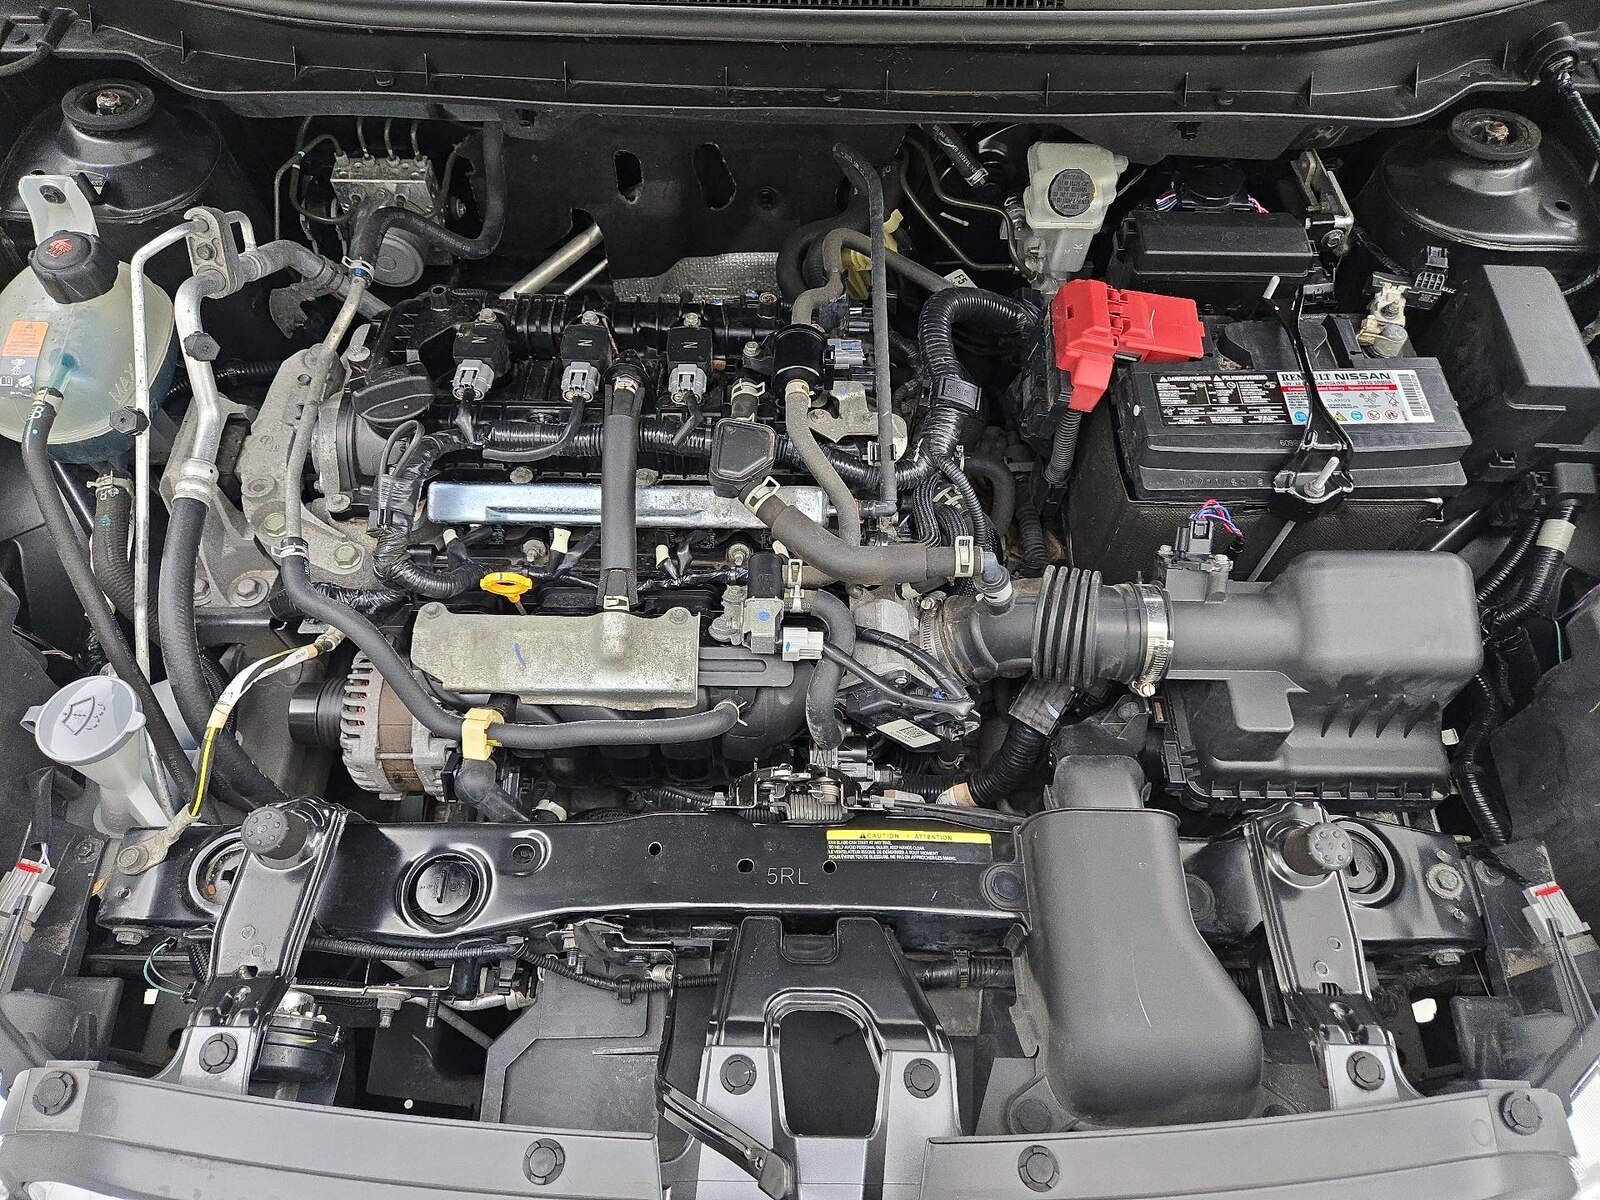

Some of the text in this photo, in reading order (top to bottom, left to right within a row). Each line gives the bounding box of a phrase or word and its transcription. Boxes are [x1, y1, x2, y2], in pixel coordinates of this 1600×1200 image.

[954, 273, 968, 285] F5
[1334, 372, 1391, 381] NISSAN
[766, 867, 809, 885] 5RL
